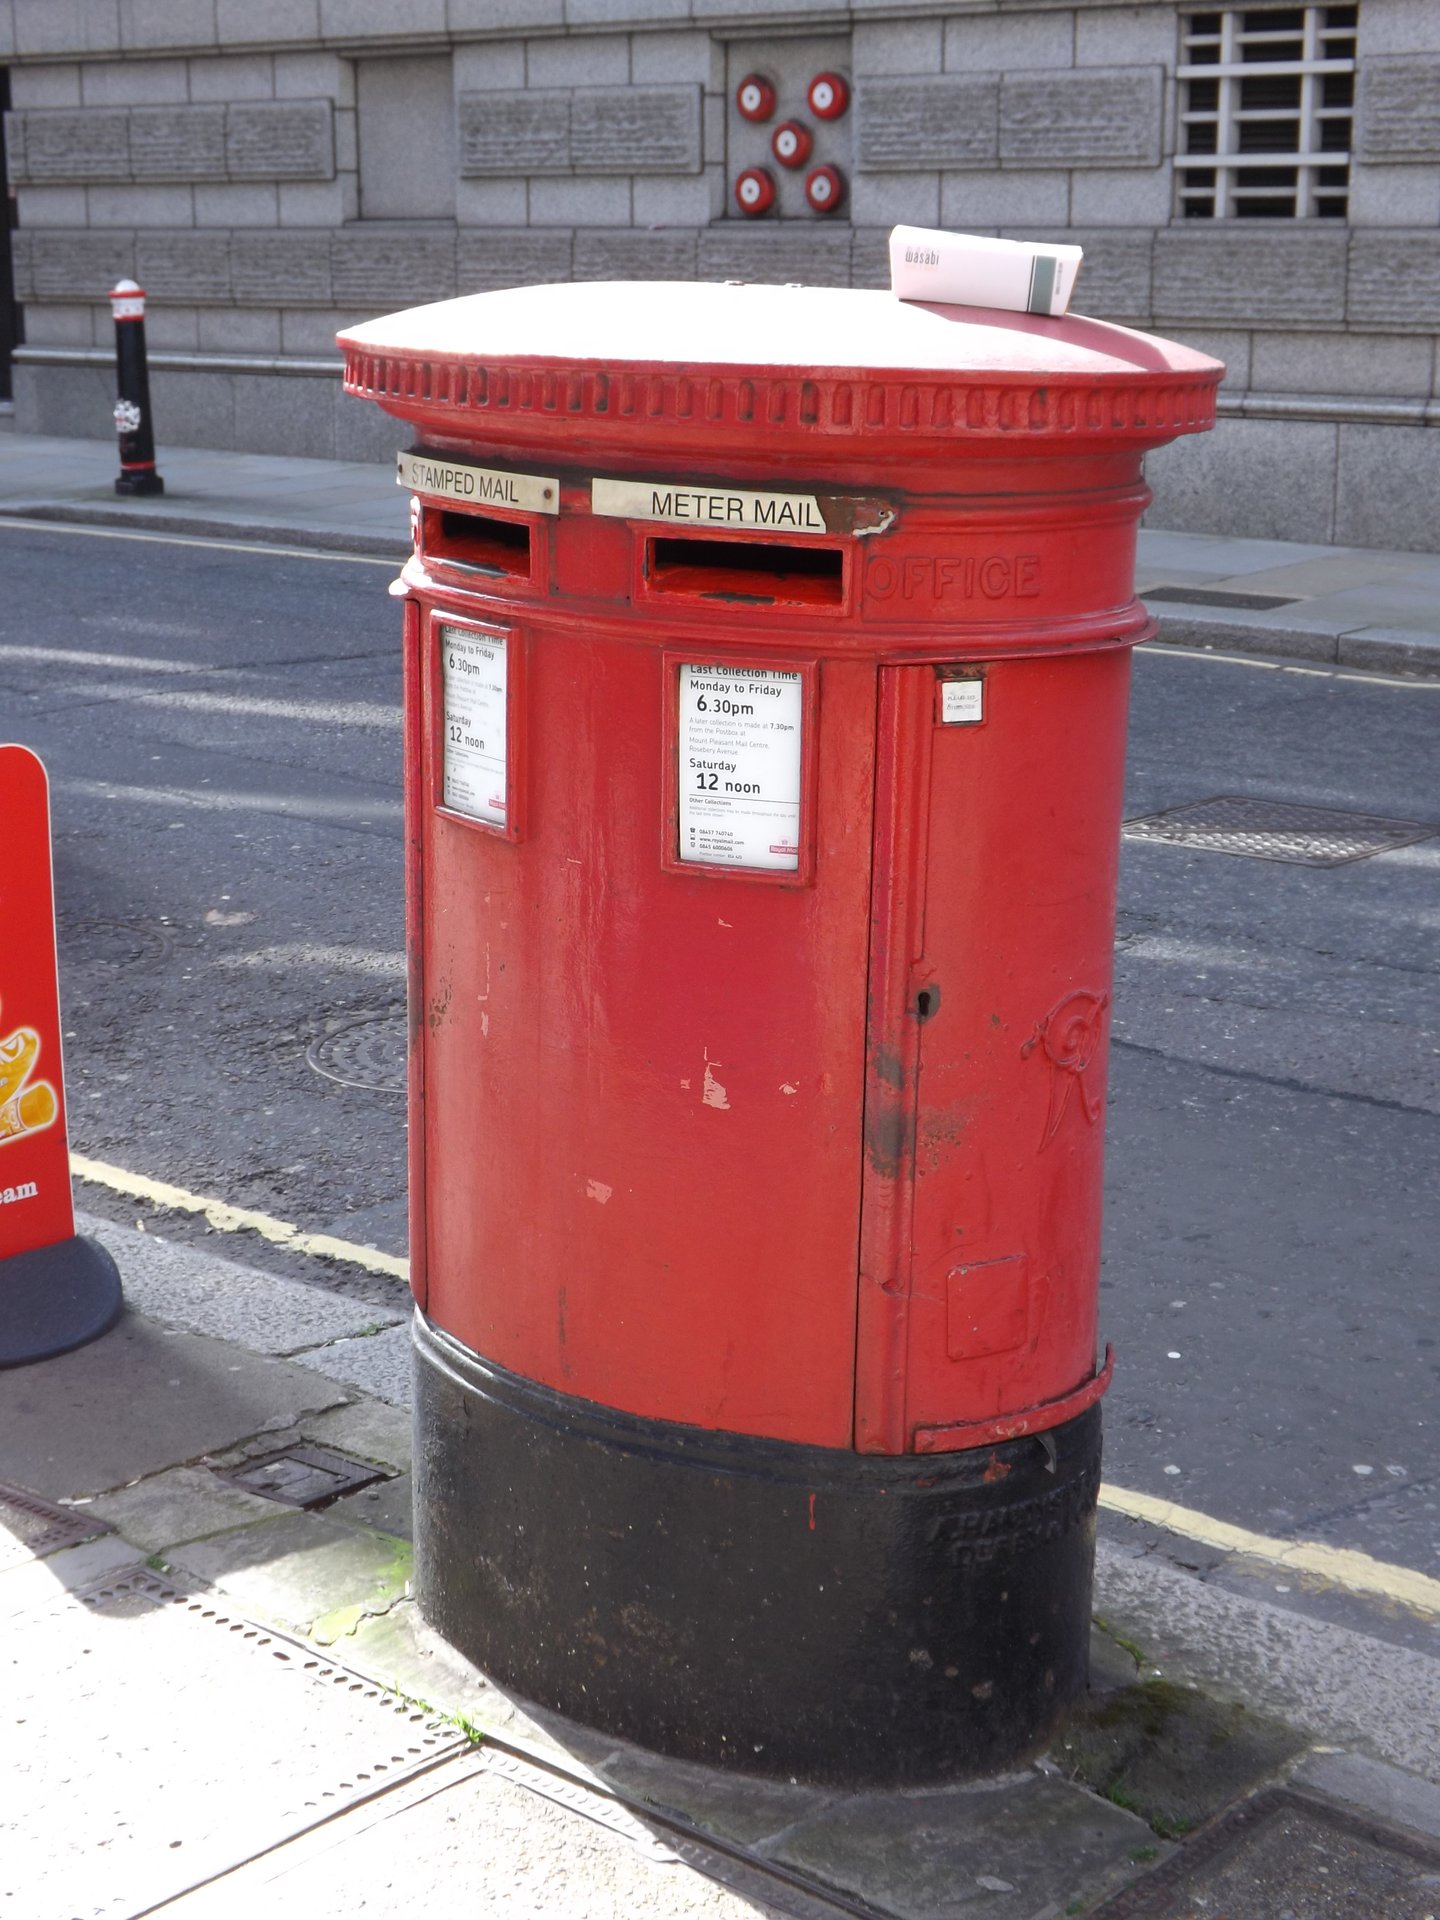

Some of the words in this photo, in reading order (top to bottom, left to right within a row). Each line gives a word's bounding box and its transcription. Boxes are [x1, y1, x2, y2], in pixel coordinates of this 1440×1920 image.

[905, 250, 940, 266] wasabi
[411, 462, 475, 495] STAMPED
[479, 476, 519, 503] MAIL
[652, 491, 744, 522] METER
[754, 499, 821, 527] MAIL
[865, 554, 1041, 600] OFFICE
[445, 638, 466, 654] Monday
[475, 645, 495, 661] Friday
[449, 653, 480, 676] 6.30pm
[690, 664, 712, 675] Last
[716, 667, 767, 679] Collection
[690, 680, 730, 694] Monday
[734, 684, 745, 693] to
[749, 684, 782, 698] Friday
[697, 694, 754, 717] 6.30pm
[446, 711, 471, 728] Saturday
[769, 723, 795, 731] 7.30pm
[450, 725, 462, 743] 12
[464, 735, 485, 750] noon
[689, 758, 737, 773] Saturday
[696, 772, 718, 790] 12
[725, 782, 761, 794] noon
[0, 1181, 38, 1203] am
